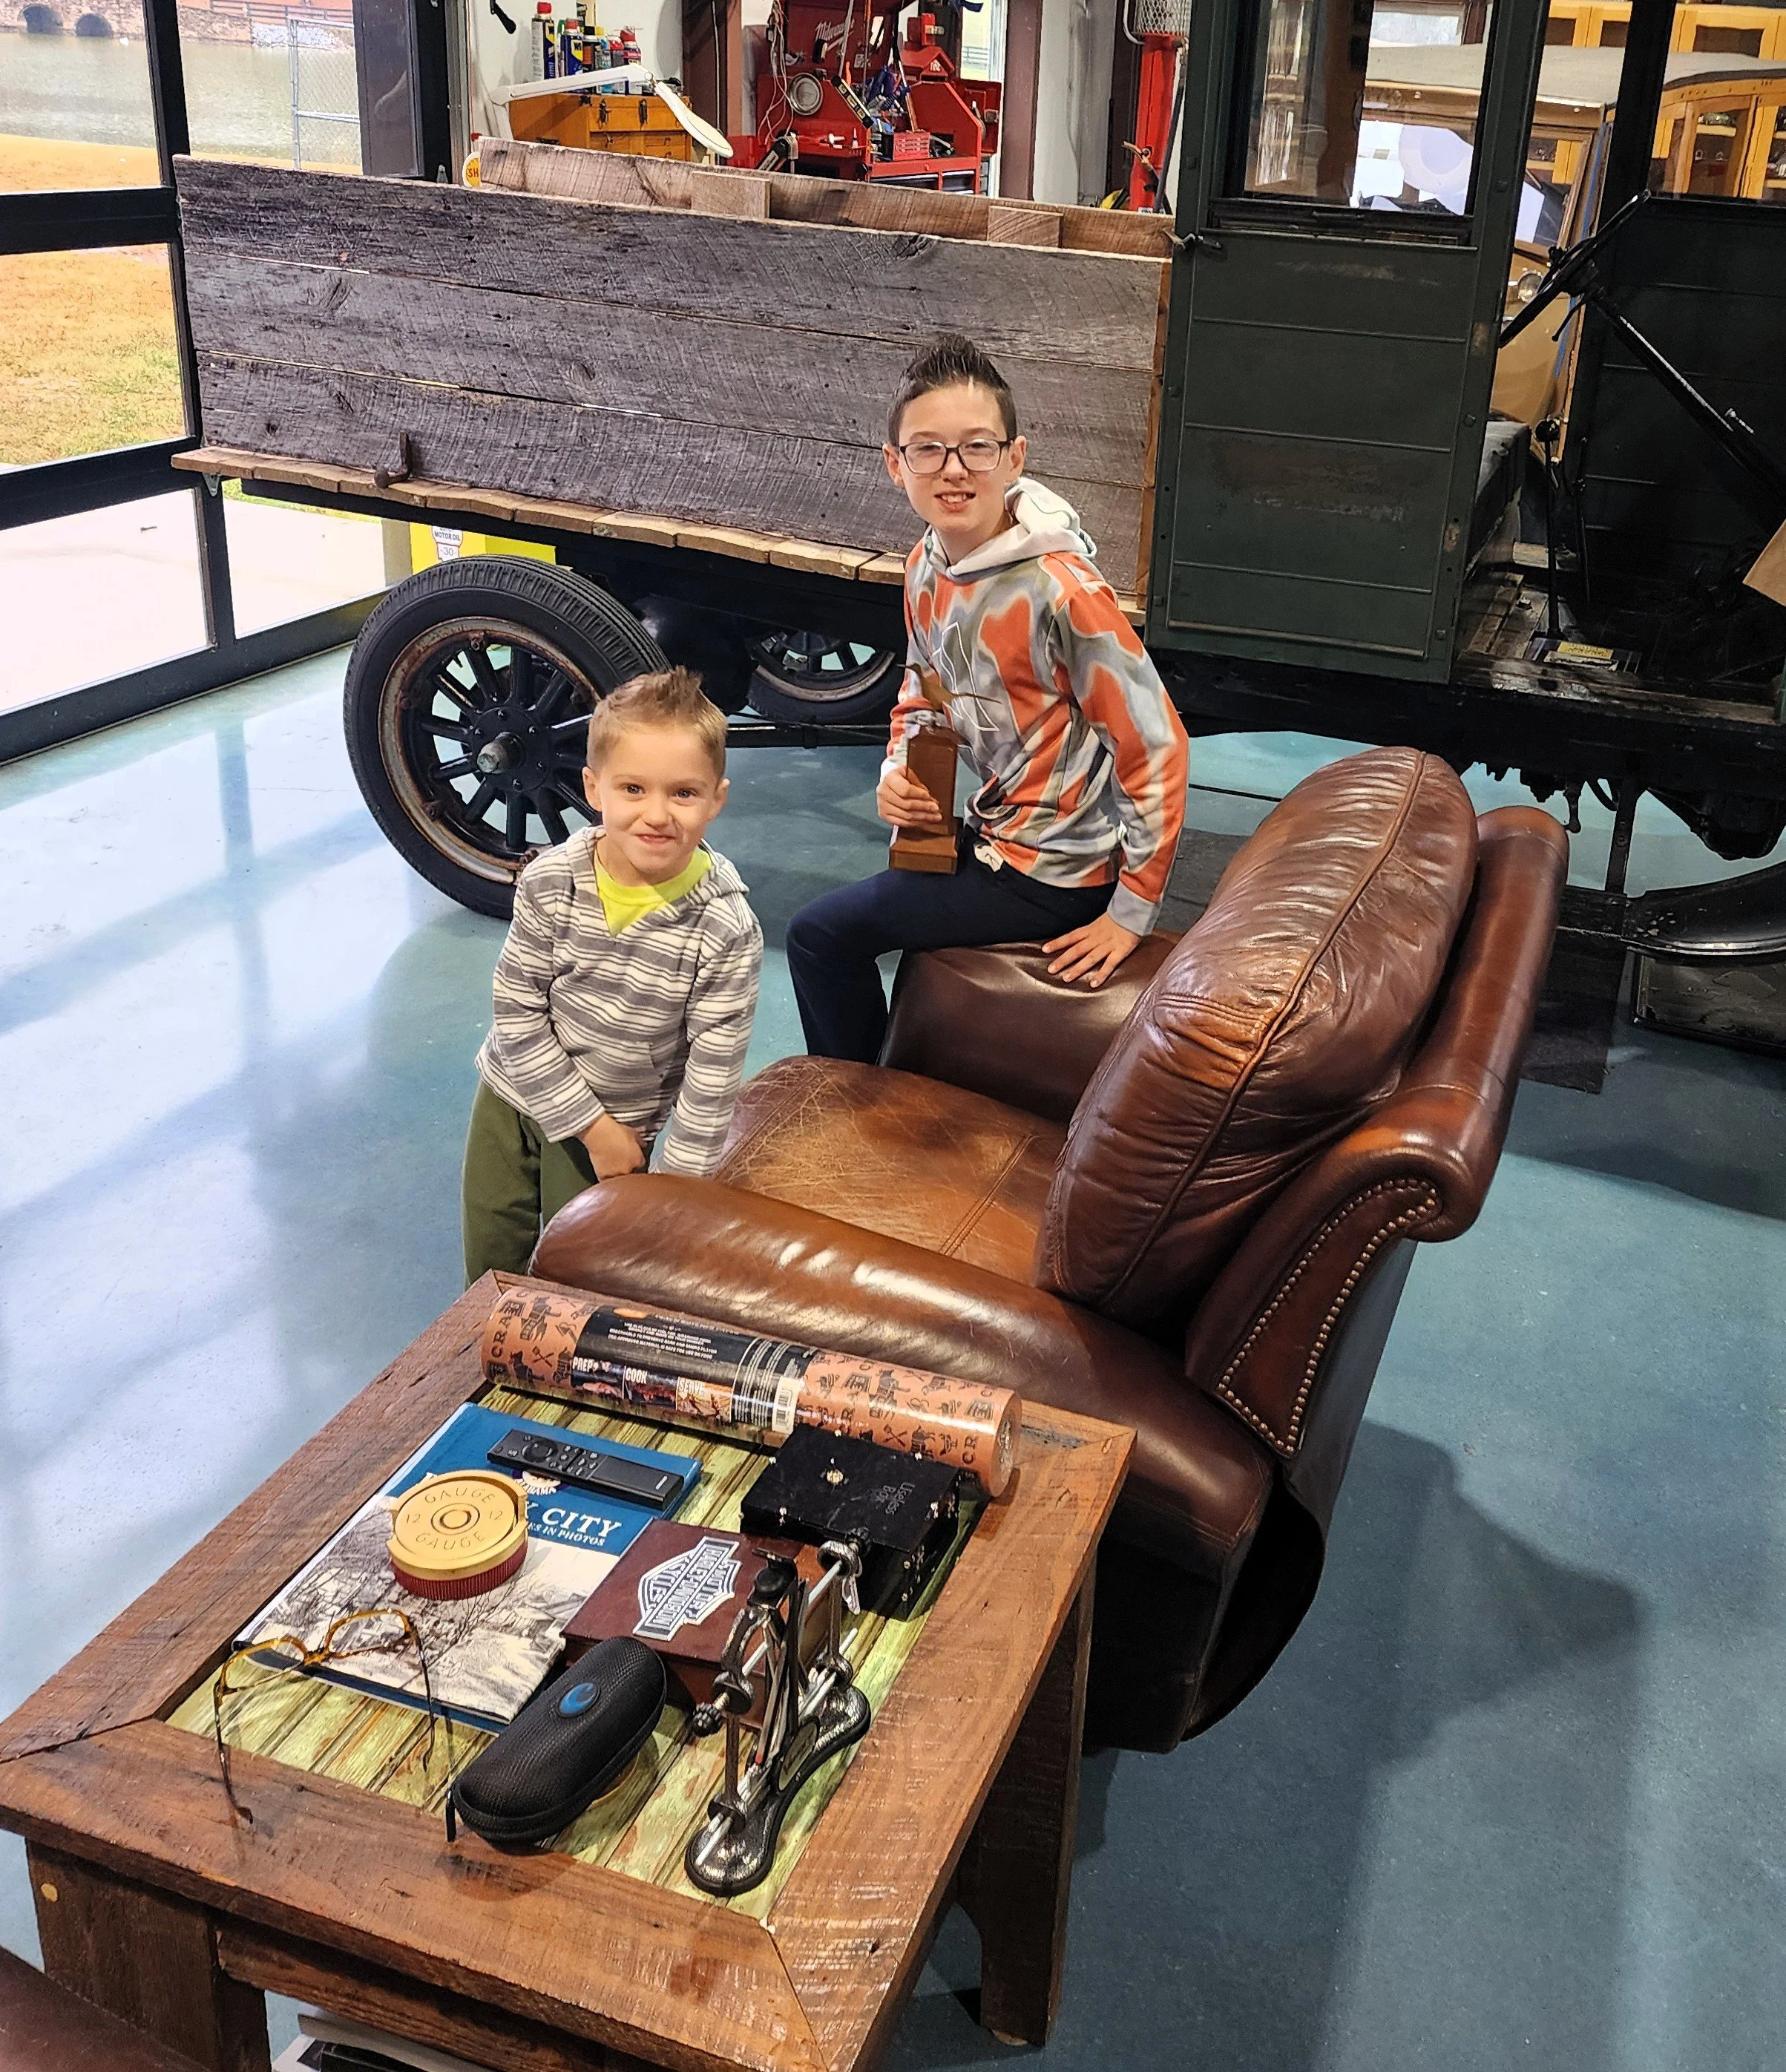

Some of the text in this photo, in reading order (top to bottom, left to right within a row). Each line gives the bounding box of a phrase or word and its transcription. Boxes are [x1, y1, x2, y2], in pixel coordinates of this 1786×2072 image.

[815, 18, 854, 42] Milwau
[468, 168, 479, 177] SH
[435, 531, 452, 540] MOTOR
[626, 1367, 648, 1384] COOK
[678, 1379, 706, 1396] SERVE
[424, 1487, 496, 1504] GAUGE
[885, 1483, 916, 1515] Useless
[406, 1513, 421, 1524] 12
[489, 1510, 503, 1521] 12
[542, 1508, 622, 1538] CITY
[416, 1531, 486, 1550] GAUGE
[542, 1526, 557, 1536] IN
[557, 1530, 605, 1547] PHOTOS
[651, 1548, 723, 1625] HARLEY-DAVIDSON
